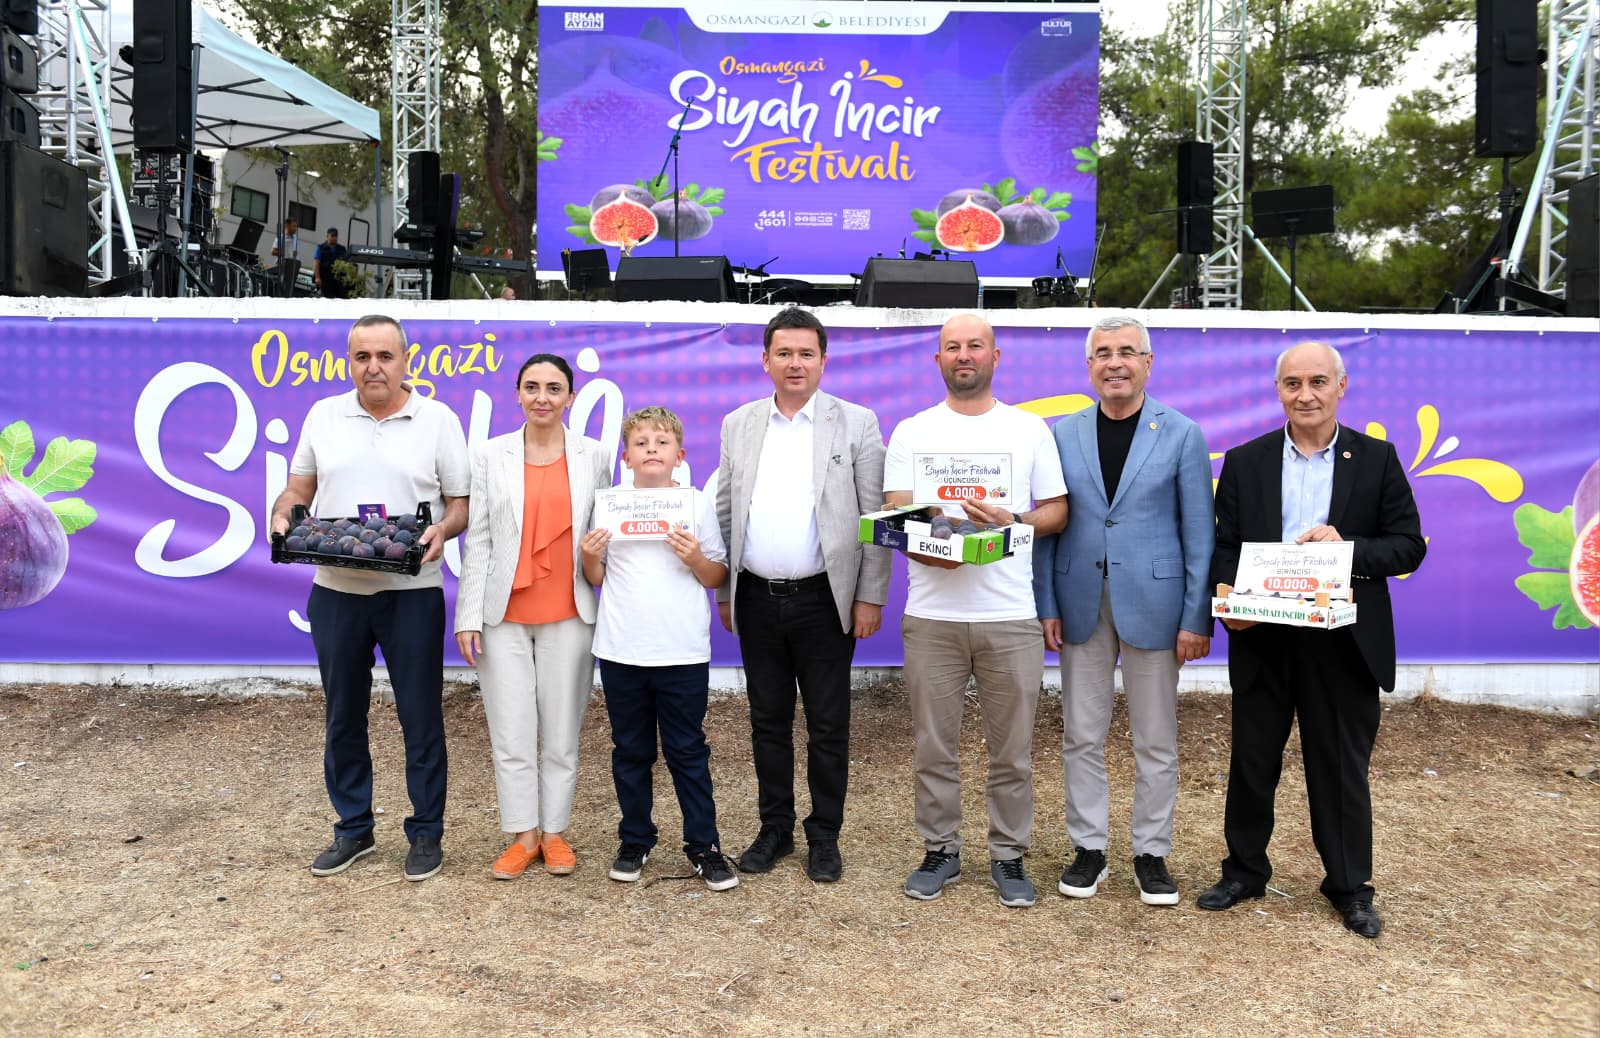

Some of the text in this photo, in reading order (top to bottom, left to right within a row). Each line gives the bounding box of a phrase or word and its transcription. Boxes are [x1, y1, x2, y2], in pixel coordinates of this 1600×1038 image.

[564, 12, 604, 21] ERKAN
[706, 14, 927, 28] OSMANGAZİ BELEDİYESİ
[567, 20, 602, 28] AYDIN
[719, 55, 827, 84] Osmangazi
[667, 69, 942, 148] Siyah İncir
[730, 136, 917, 184] Festivali
[758, 210, 785, 218] 444
[759, 218, 786, 227] 1601
[251, 328, 504, 400] Osmgazi
[925, 464, 949, 478] Siyah
[969, 464, 1001, 476] Festivali
[919, 541, 952, 557] EKİNCİ
[1232, 605, 1257, 616] BURSA
